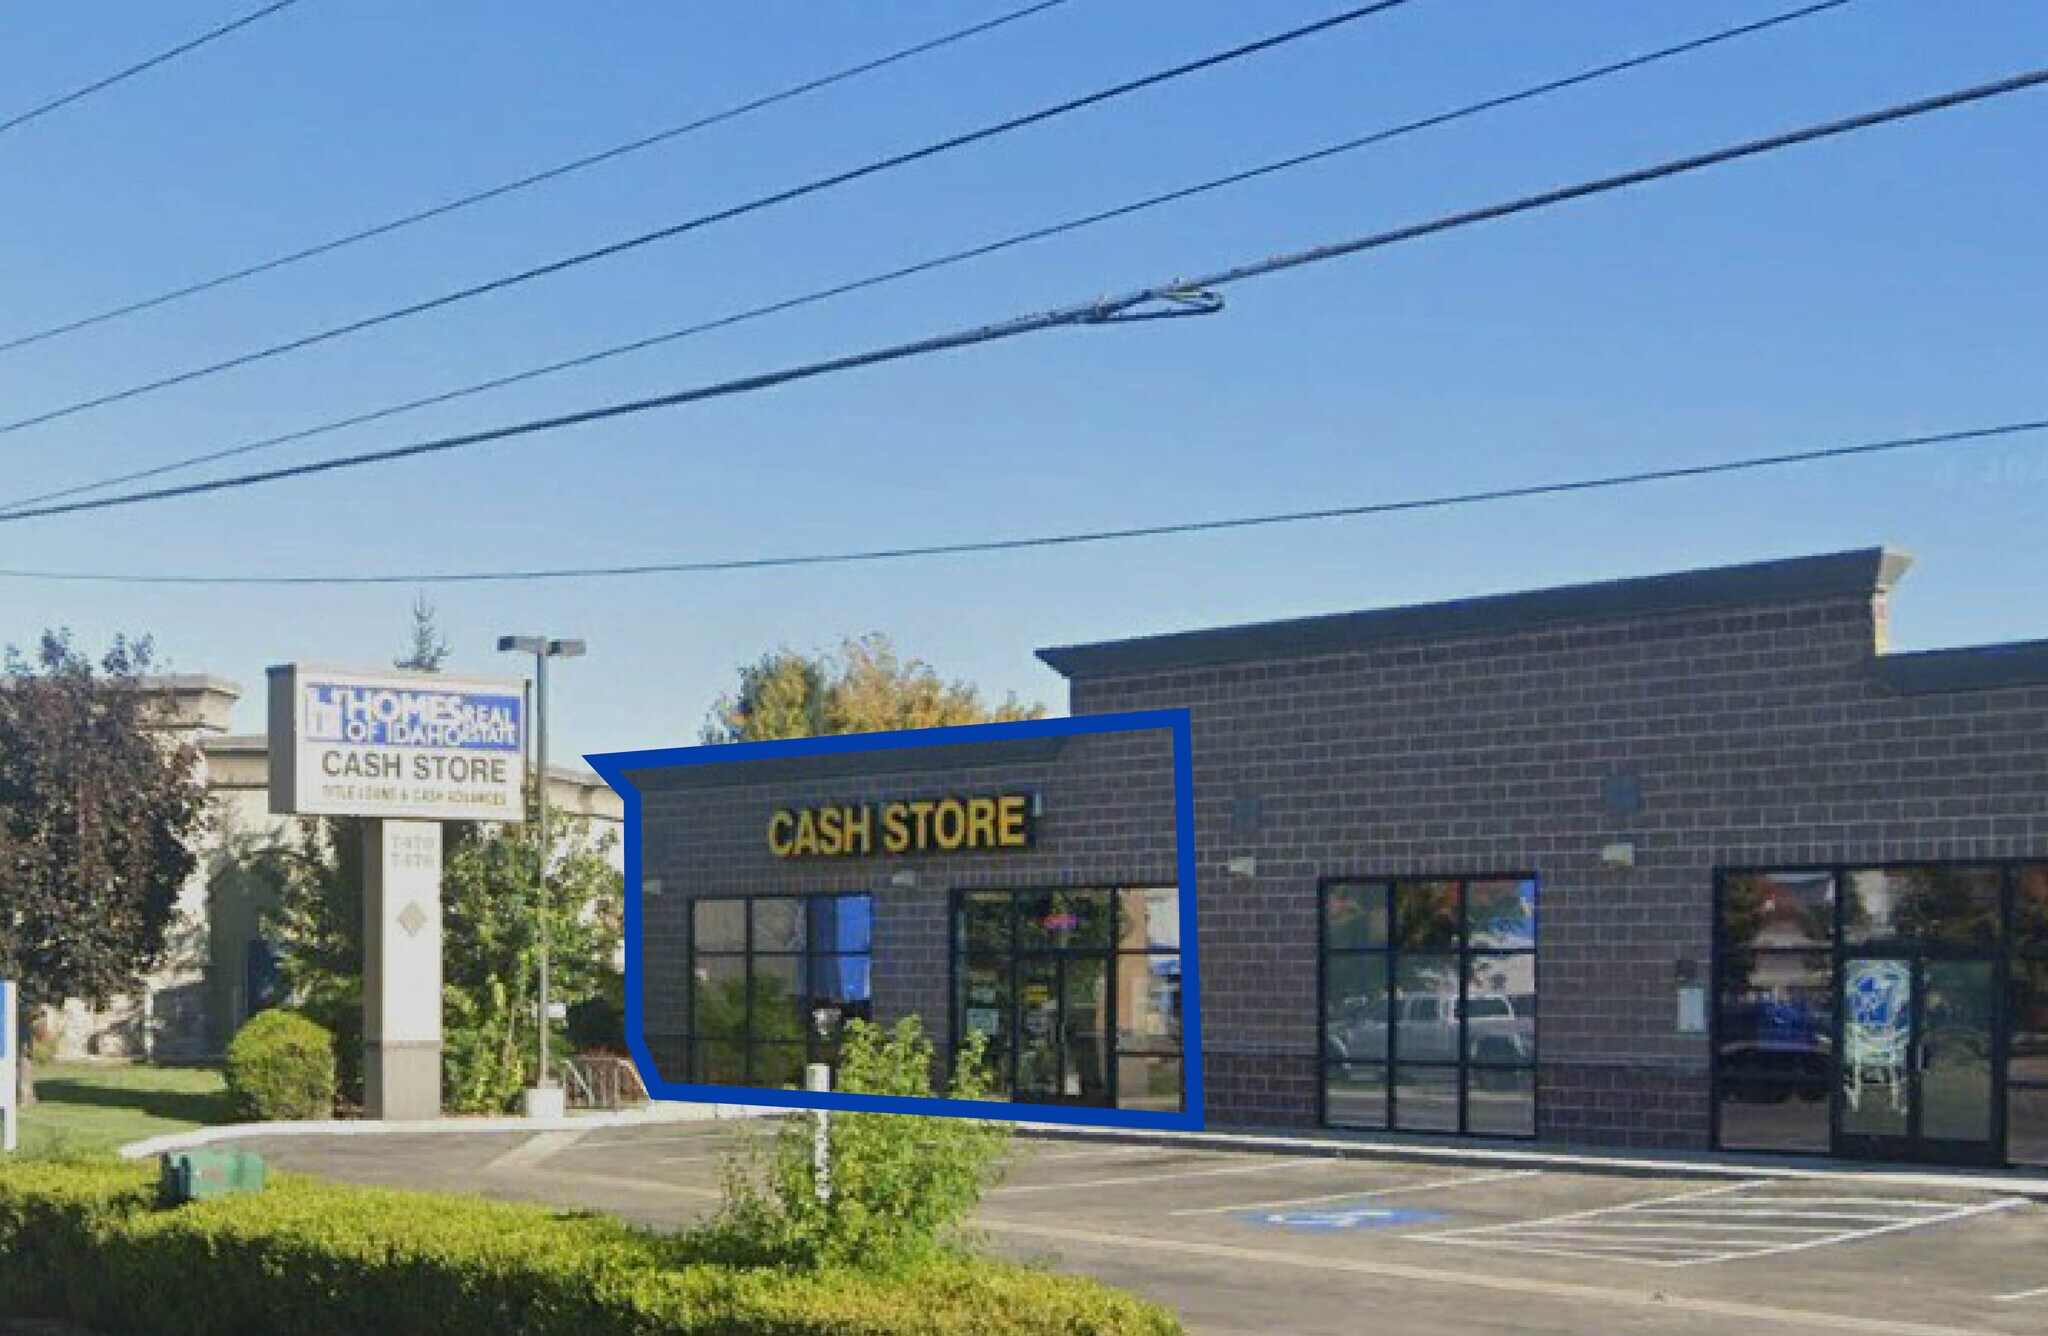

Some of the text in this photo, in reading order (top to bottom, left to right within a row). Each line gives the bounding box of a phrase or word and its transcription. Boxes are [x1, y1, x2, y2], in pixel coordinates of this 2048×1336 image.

[347, 687, 464, 723] HOMES
[463, 703, 512, 724] REAL
[347, 720, 462, 746] OF IDAHO
[322, 750, 507, 784] CASH STORE
[767, 795, 1027, 858] CASH STORE
